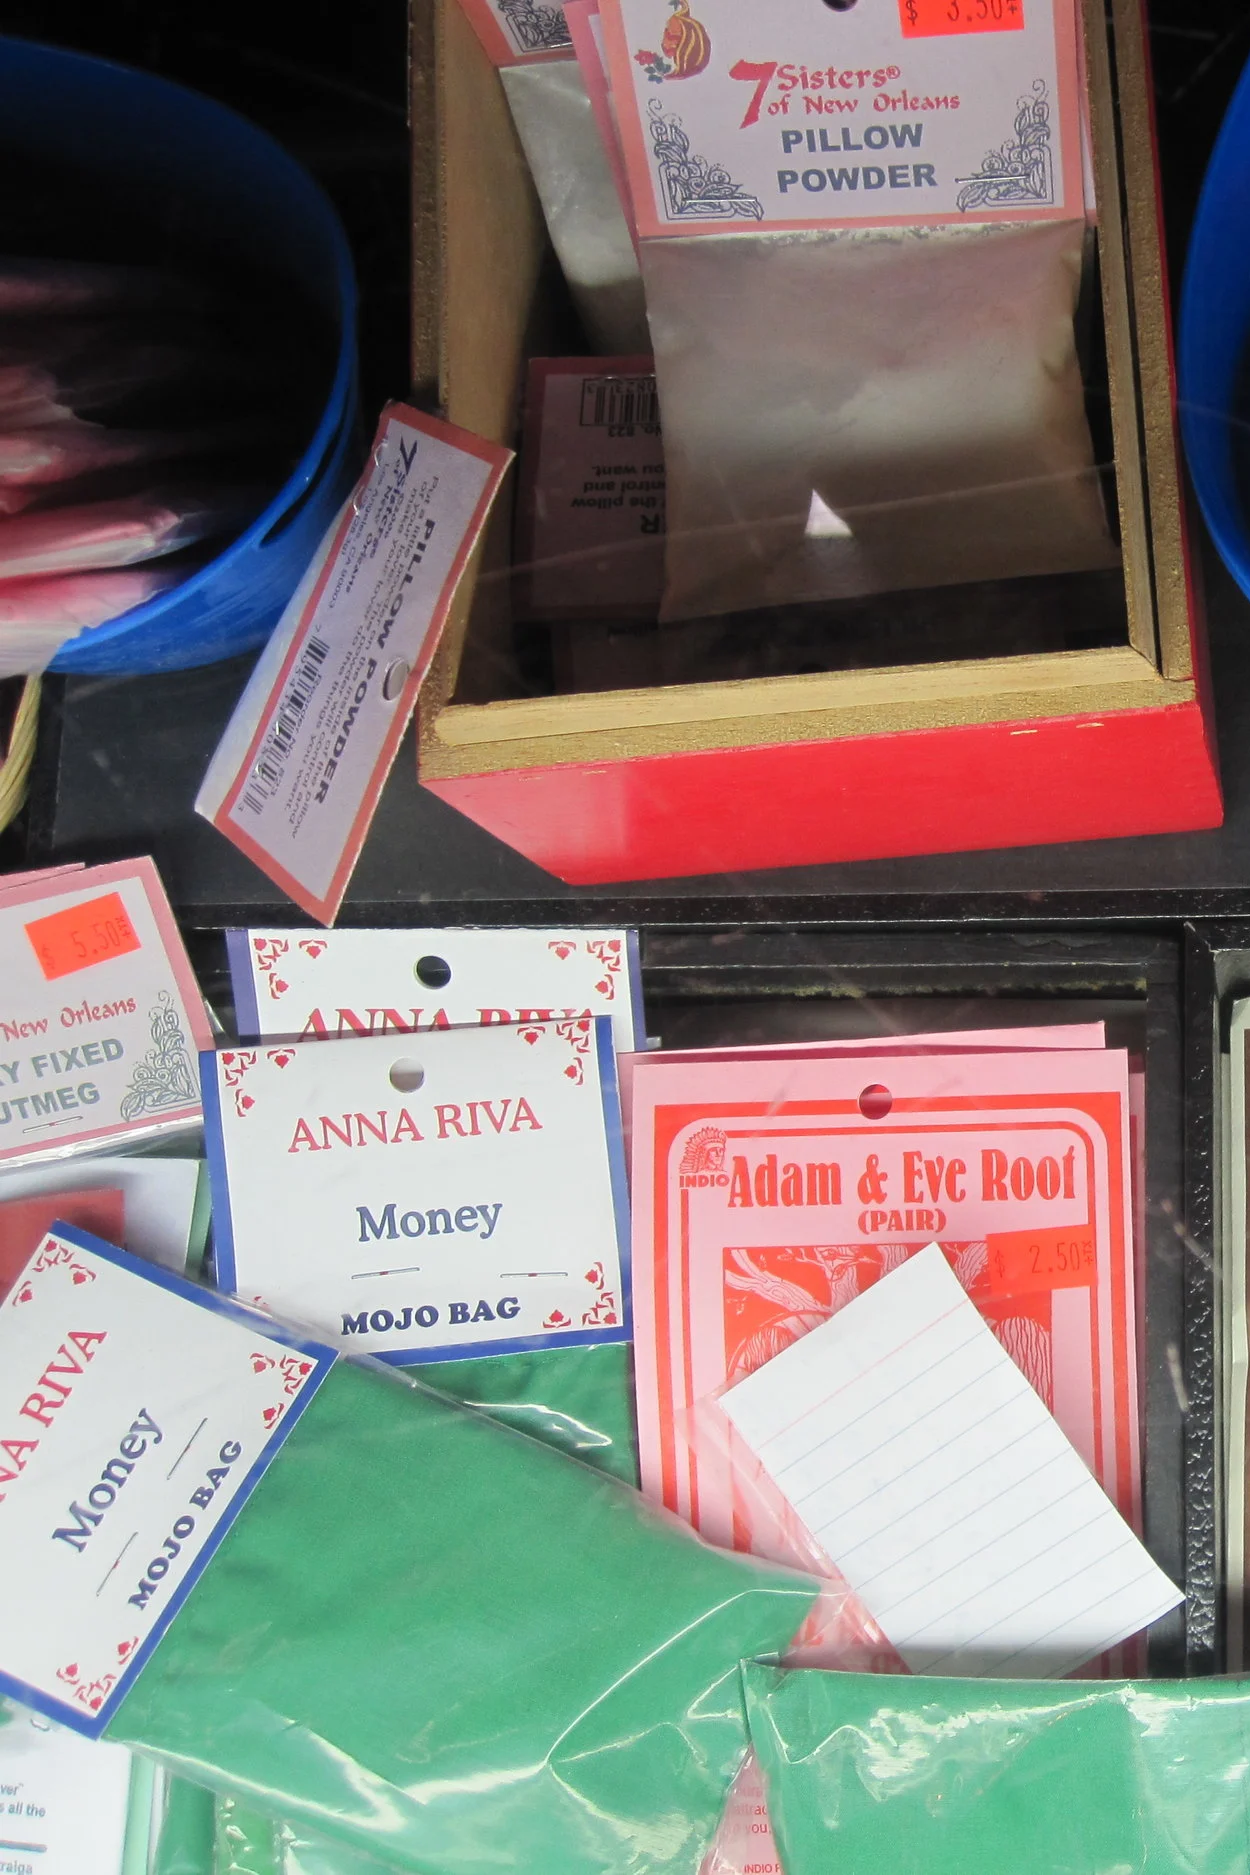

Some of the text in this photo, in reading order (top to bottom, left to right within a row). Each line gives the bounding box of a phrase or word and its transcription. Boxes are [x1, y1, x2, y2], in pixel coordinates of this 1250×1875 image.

[729, 59, 778, 129] 7
[767, 90, 960, 116] of New Orleans
[781, 123, 924, 153] PILLOW
[777, 164, 938, 193] POWDER
[314, 519, 435, 803] PILLOW POWDER
[0, 997, 137, 1042] New Orleans
[31, 1038, 125, 1078] FIXED
[288, 1097, 543, 1153] ANNA RIVA
[679, 1174, 729, 1188] INDIO
[727, 1145, 1076, 1208] Adam & Eve Root
[356, 1203, 503, 1242] Money
[857, 1208, 947, 1235] (PAIR)
[1029, 1244, 1081, 1275] 2.50
[340, 1297, 521, 1335] MOJO BAG
[19, 1331, 108, 1428] RIVA
[52, 1407, 163, 1553] Money
[128, 1440, 242, 1611] MOJO BAG
[9, 1802, 46, 1817] all the
